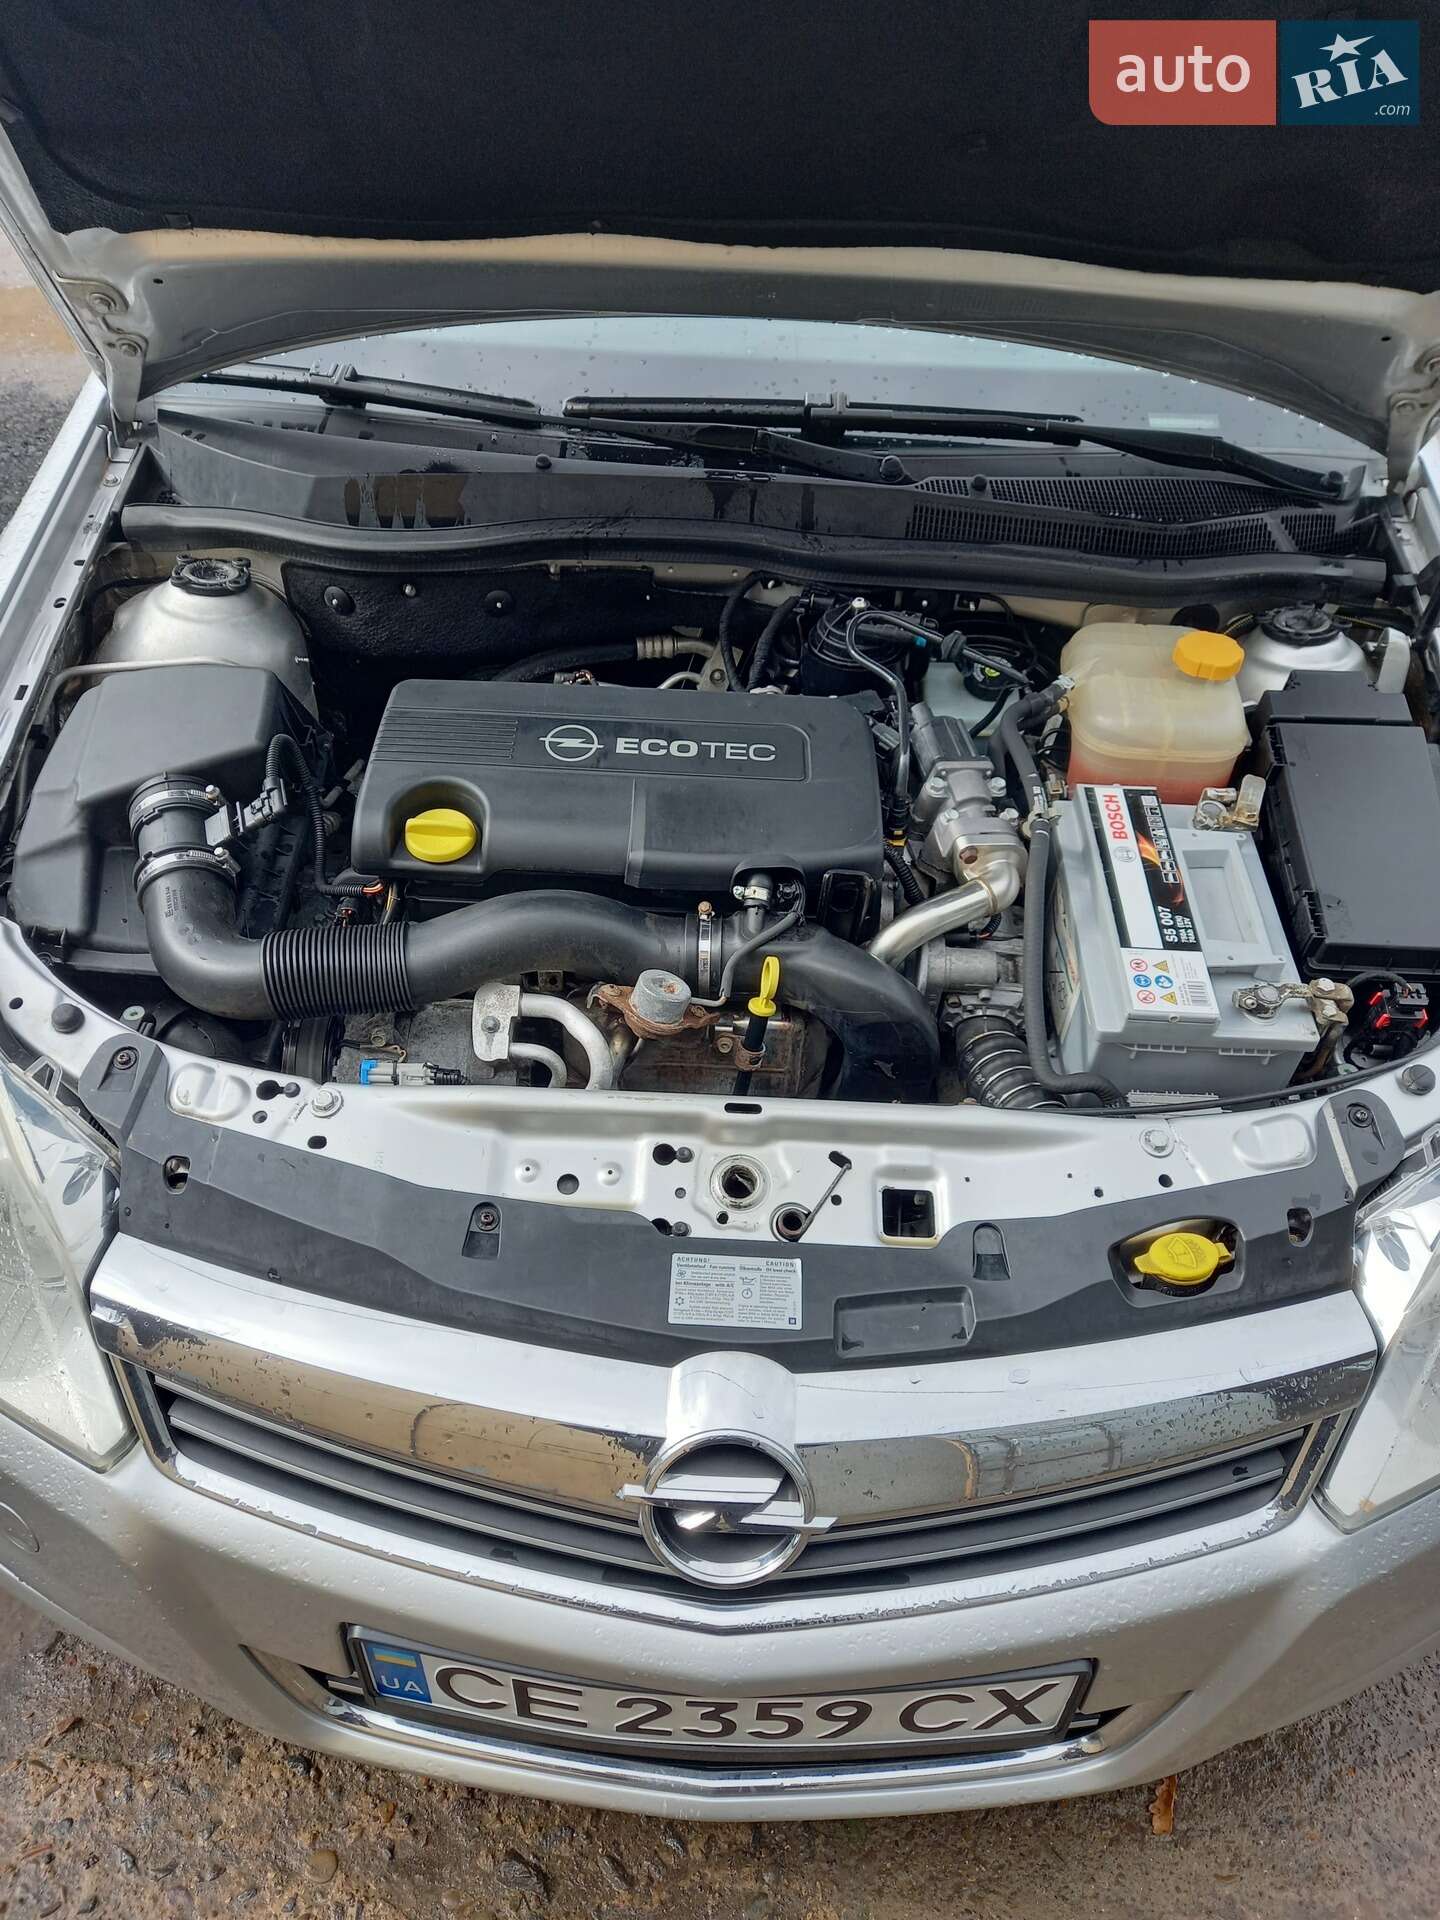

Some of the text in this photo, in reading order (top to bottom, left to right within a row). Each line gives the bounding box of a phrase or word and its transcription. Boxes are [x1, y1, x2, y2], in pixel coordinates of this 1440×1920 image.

[616, 737, 777, 762] ECOTEC
[1103, 794, 1129, 841] BOSCH
[1157, 905, 1174, 926] 007
[1163, 928, 1178, 943] S5
[380, 1674, 424, 1695] UA
[434, 1667, 1061, 1740] CE 2359 CX
